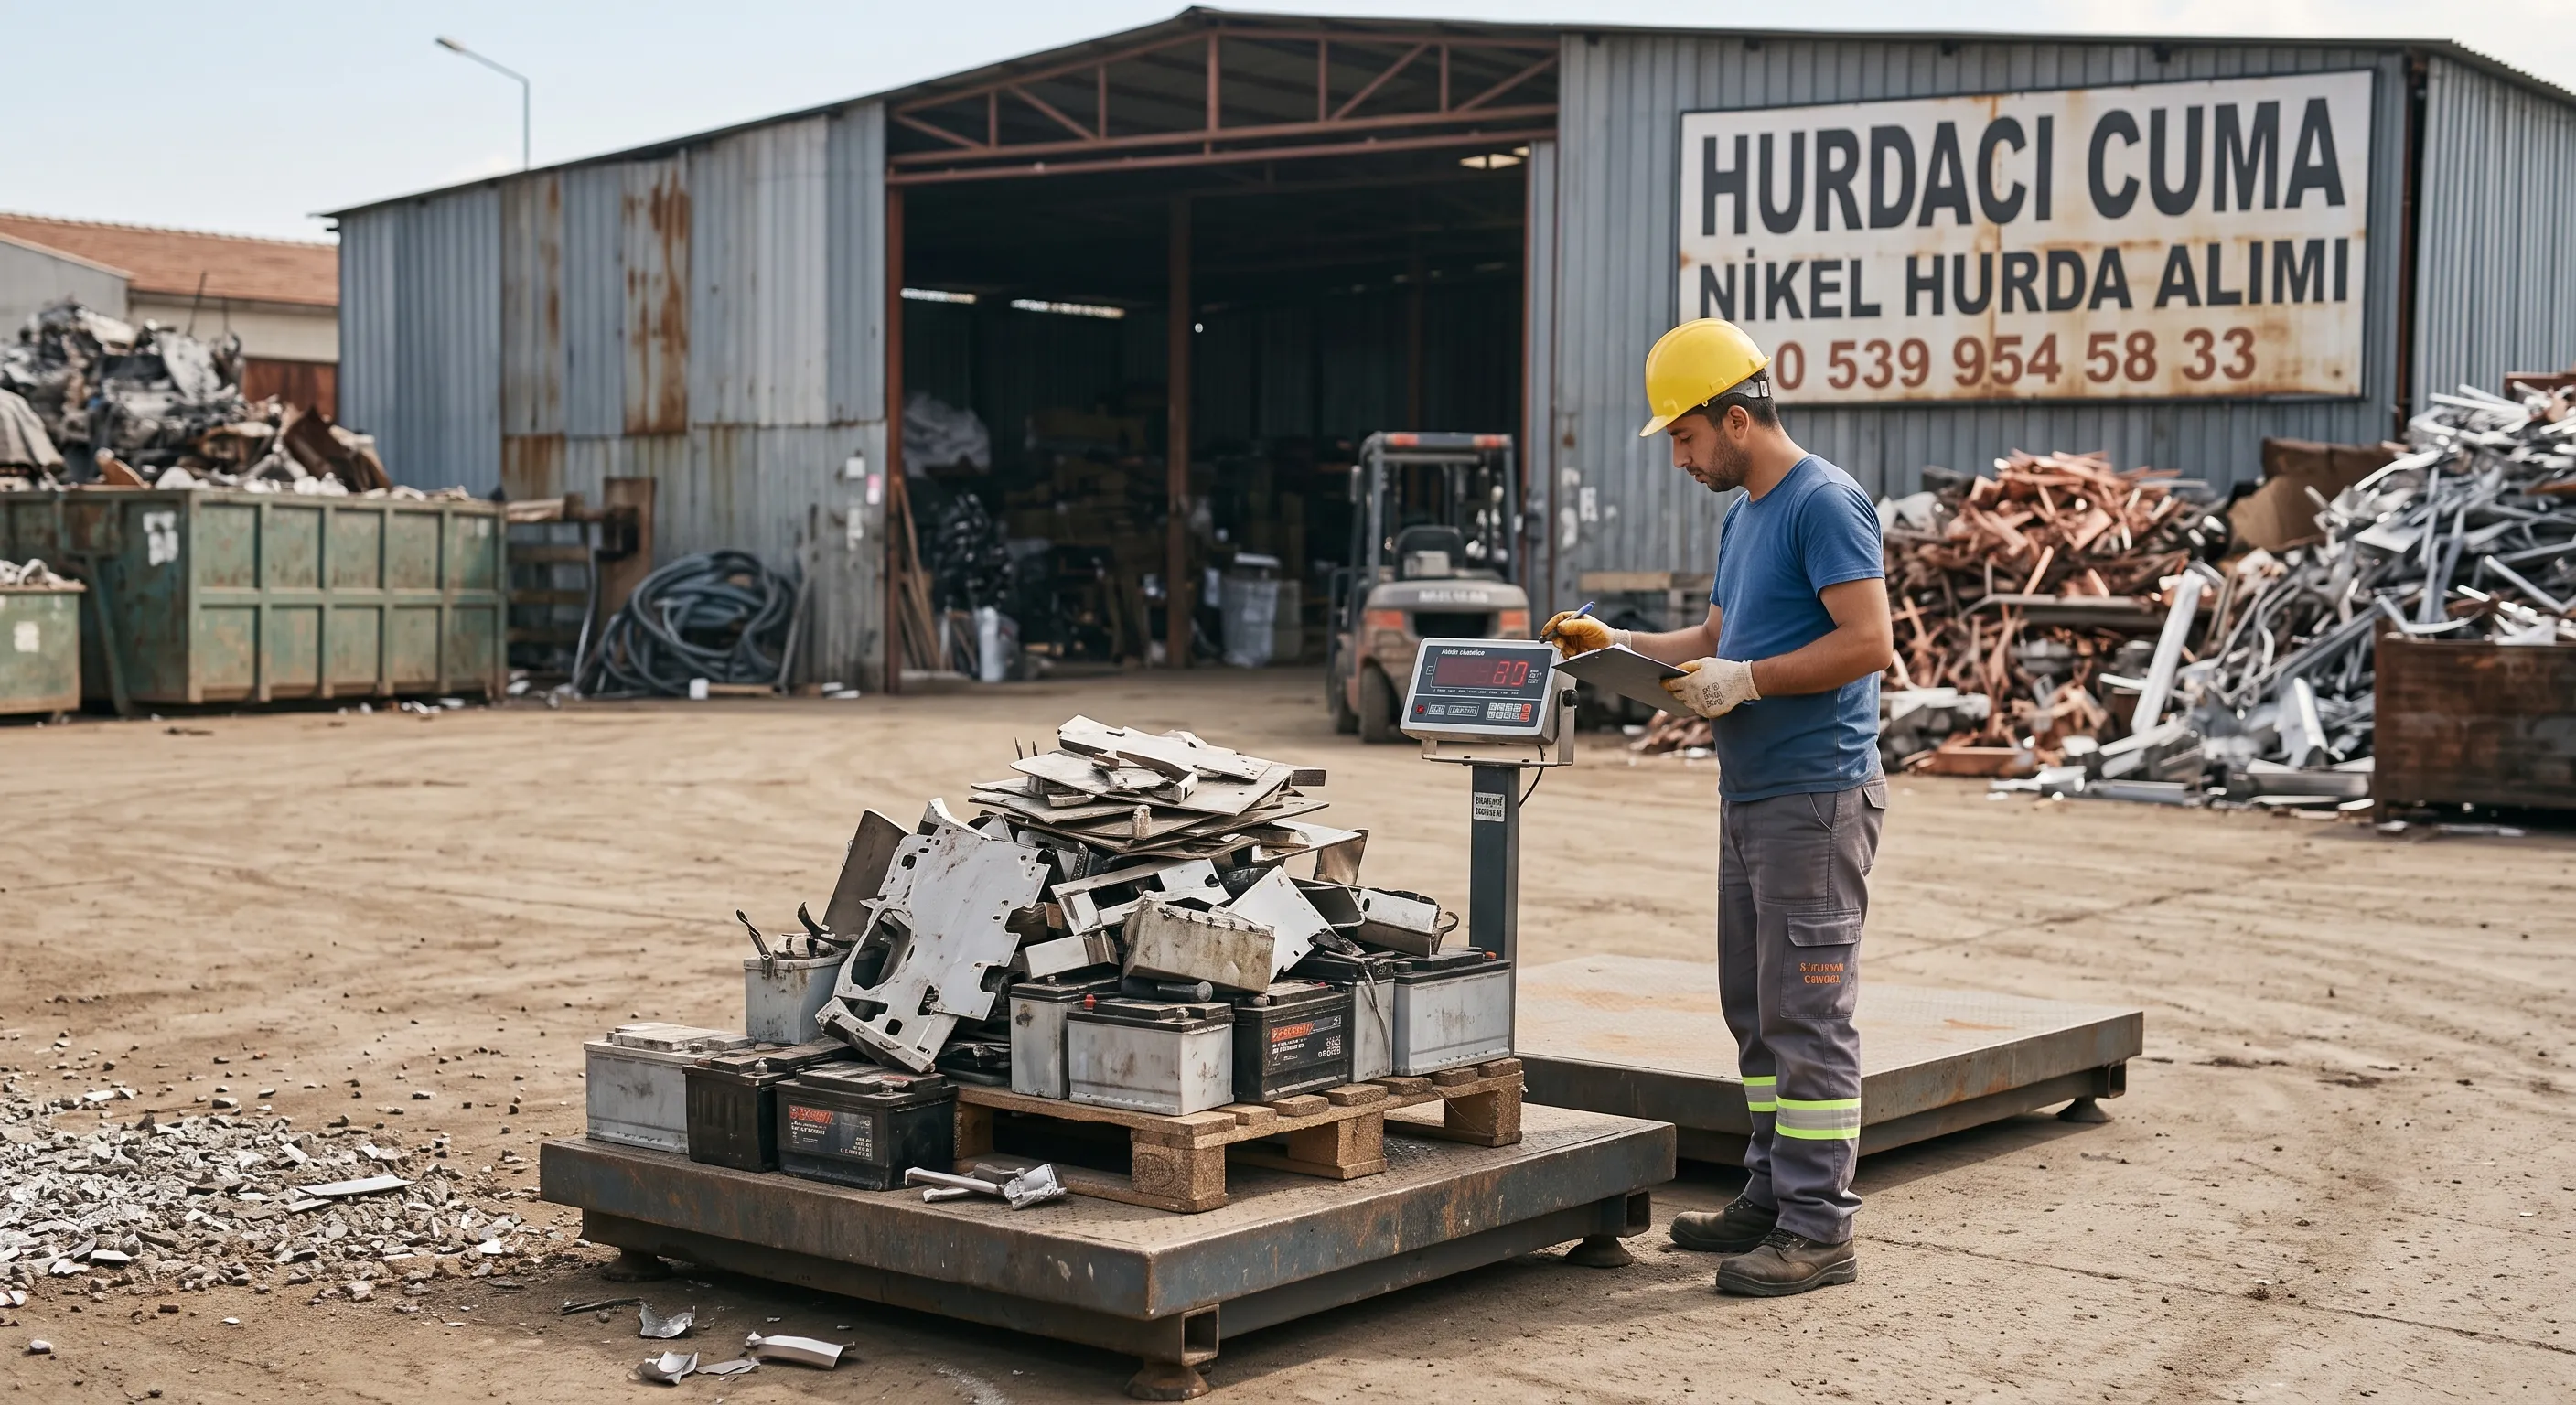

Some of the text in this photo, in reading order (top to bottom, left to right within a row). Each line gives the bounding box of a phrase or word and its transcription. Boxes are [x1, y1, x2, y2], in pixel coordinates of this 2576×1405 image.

[1702, 97, 2346, 236] HURDACI CUMA
[1700, 238, 2349, 322] NİKEL HURDA ALIMI
[1776, 327, 2257, 391] 0 539 954 58 33
